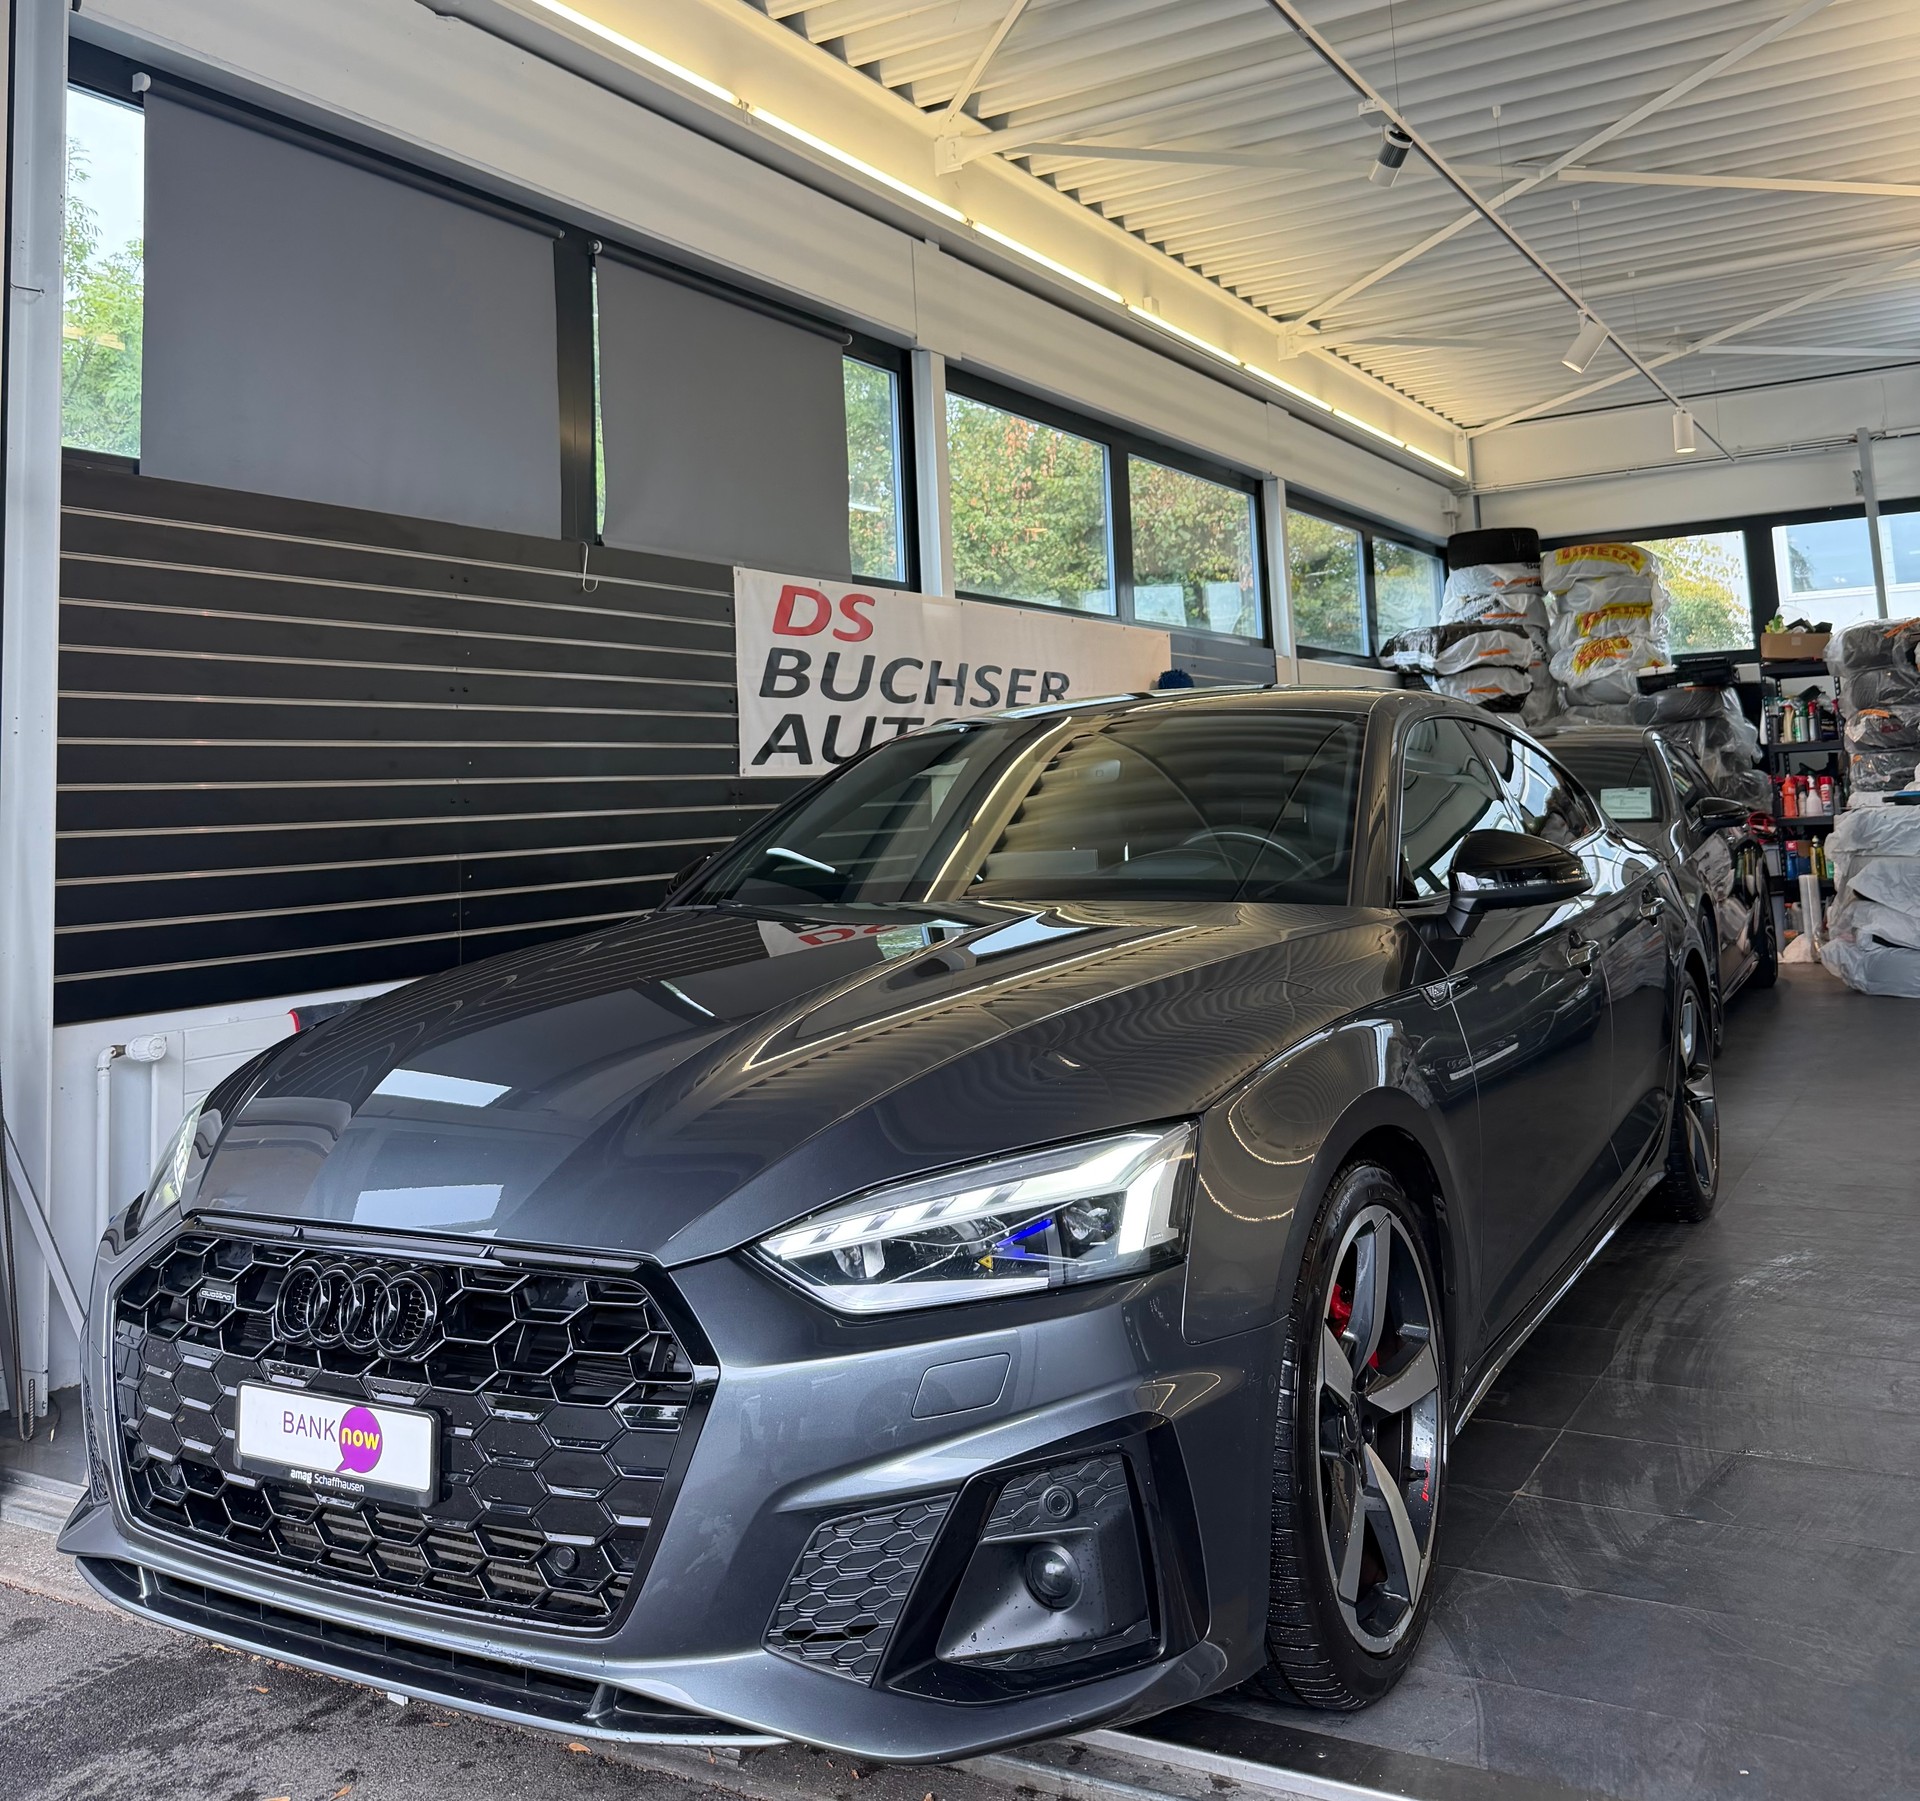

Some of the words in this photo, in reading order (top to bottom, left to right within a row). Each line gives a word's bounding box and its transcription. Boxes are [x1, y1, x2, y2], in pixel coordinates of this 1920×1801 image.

[772, 584, 876, 642] DS
[759, 647, 1070, 708] BUCHSER
[751, 713, 960, 765] AUT
[201, 1290, 232, 1301] quattro
[283, 1410, 337, 1443] BANK
[341, 1427, 380, 1451] now
[290, 1469, 312, 1484] amag
[314, 1473, 365, 1493] Schaffhausen
